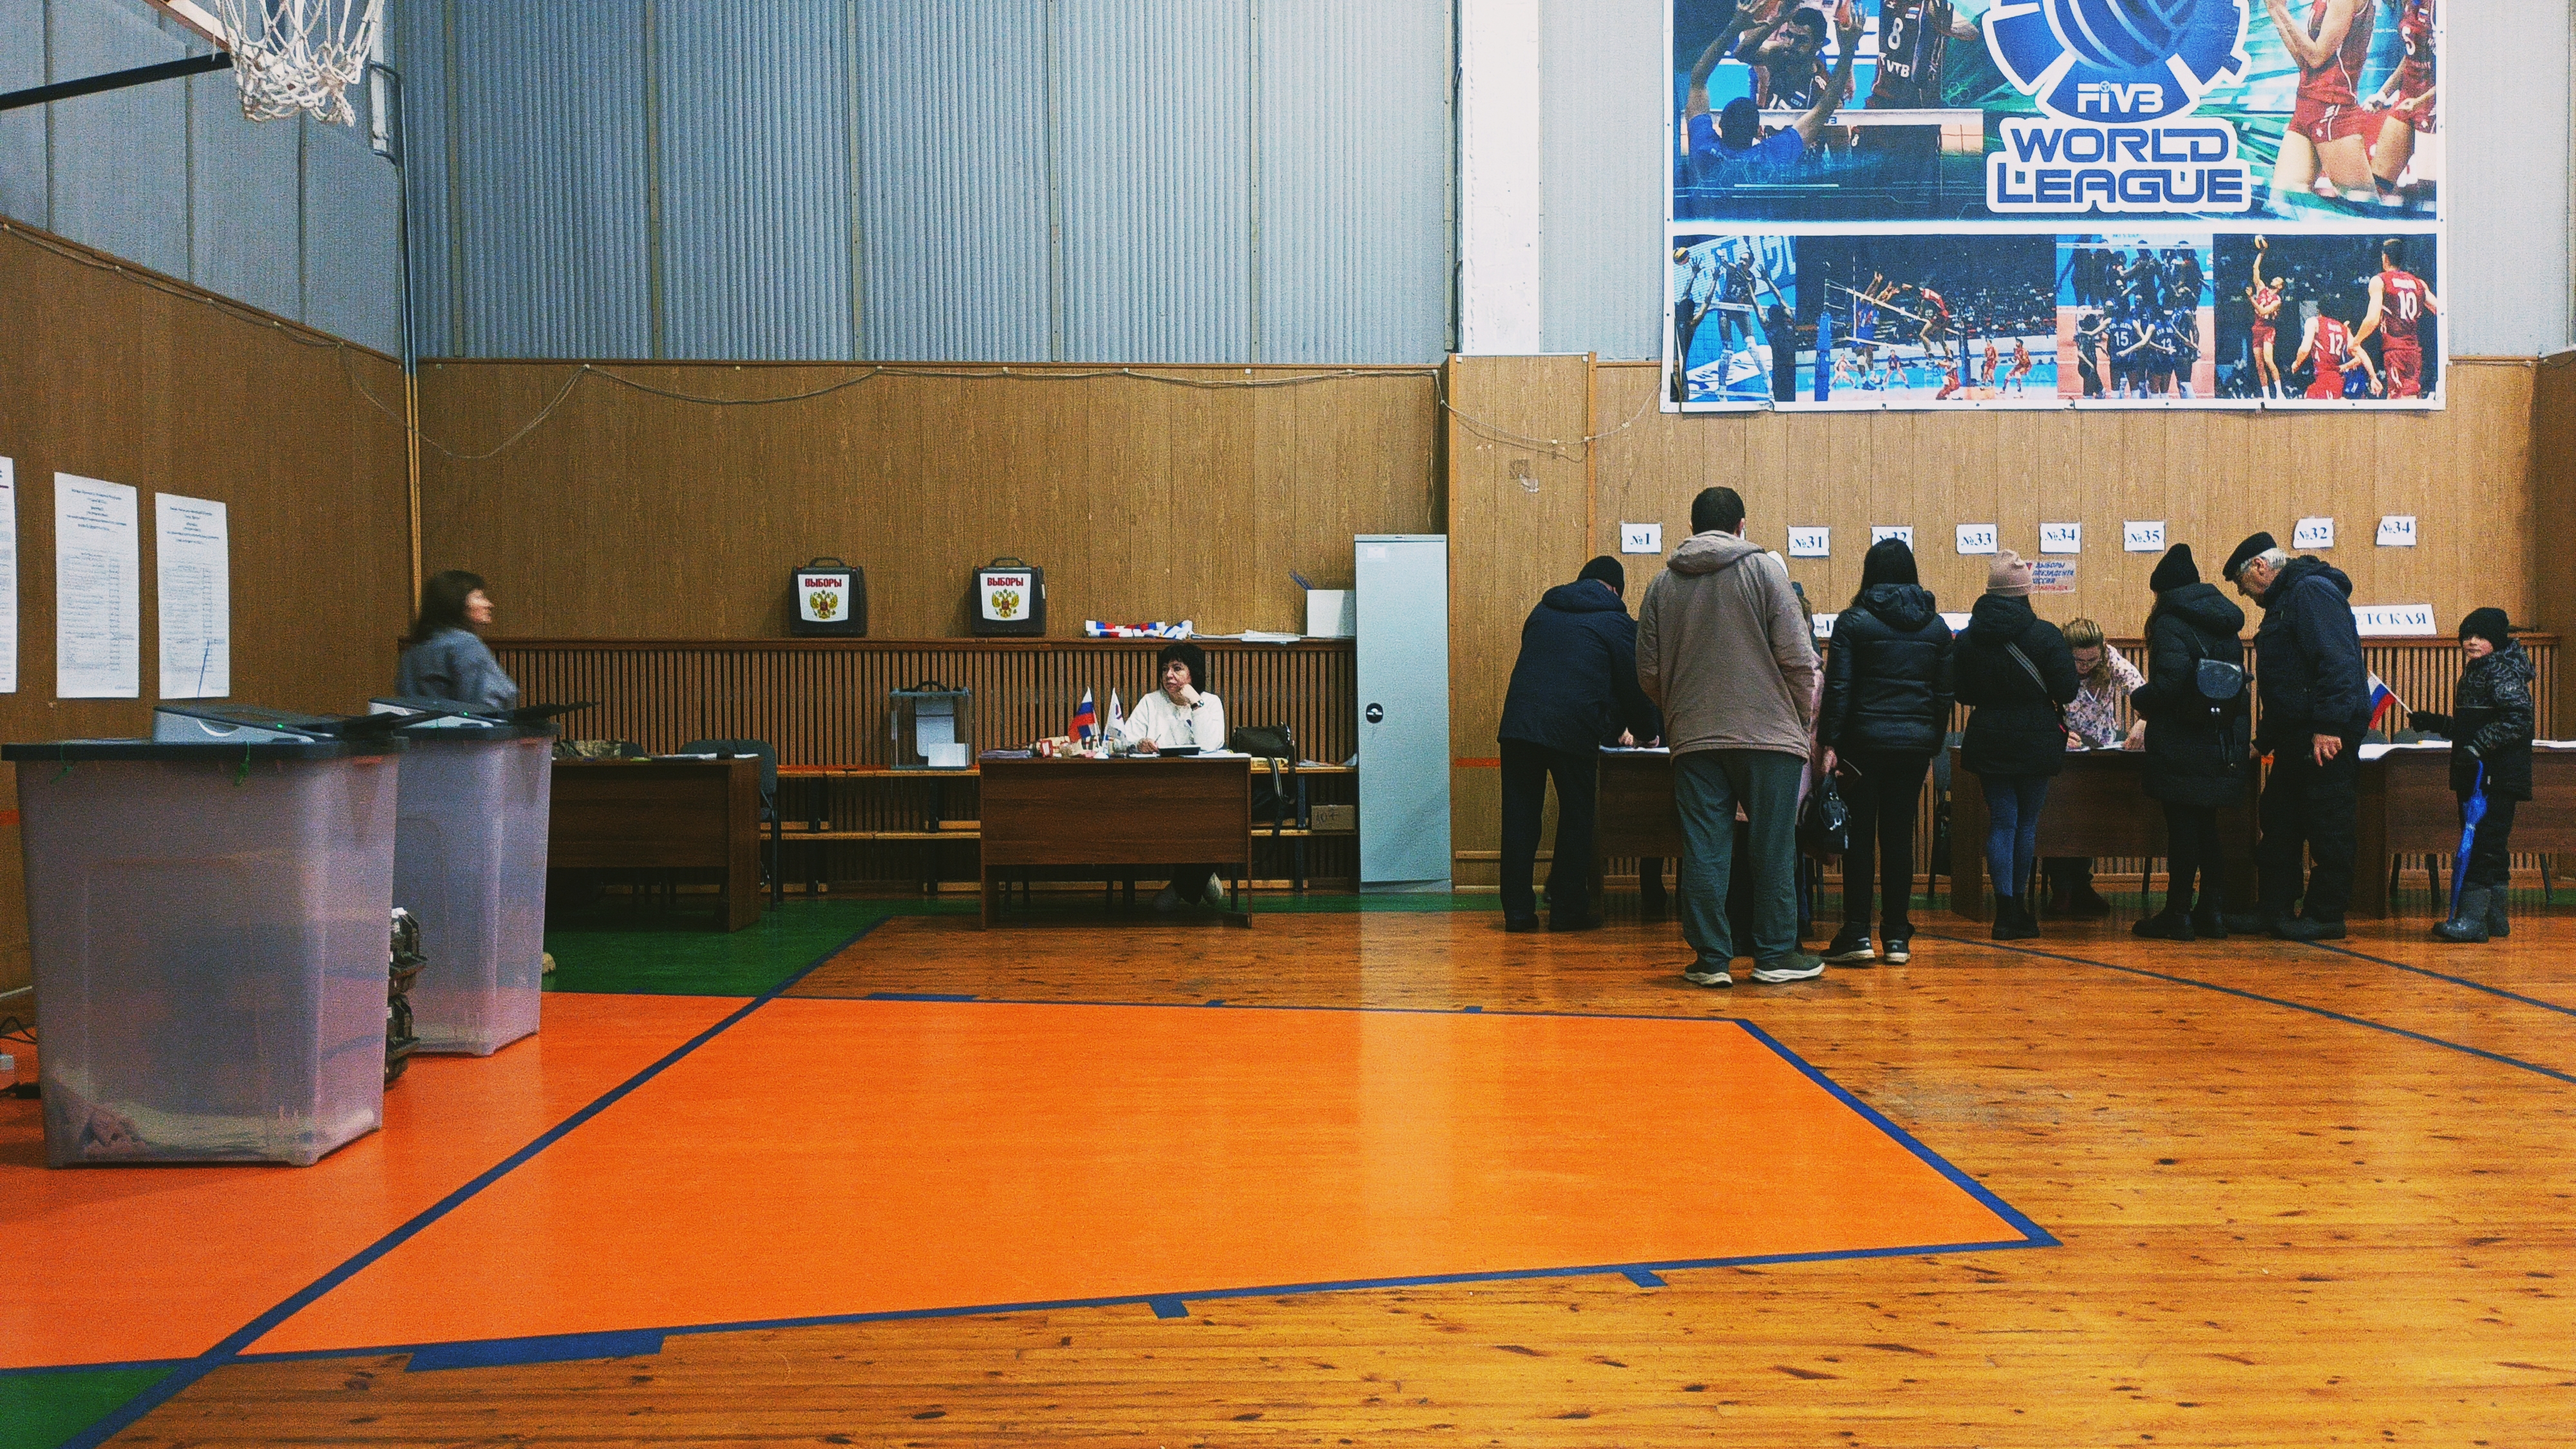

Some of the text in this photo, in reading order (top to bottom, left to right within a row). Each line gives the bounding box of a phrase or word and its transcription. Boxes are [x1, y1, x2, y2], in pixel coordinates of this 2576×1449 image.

[1888, 17, 1903, 50] 8
[1887, 59, 1910, 77] VTB
[2010, 128, 2229, 162] WORLD
[1997, 162, 2242, 204] LEAGUE
[2398, 290, 2418, 321] 10
[2114, 331, 2129, 346] 15
[2329, 332, 2344, 355] 12
[2297, 527, 2327, 540] №32
[2381, 521, 2410, 534] №34
[1630, 533, 1651, 545] №1
[1961, 533, 1992, 546] №33
[2045, 528, 2076, 542] №34
[2128, 530, 2160, 543] №35
[1793, 536, 1823, 549] №31
[805, 578, 842, 587] ВЫБОРЫ
[987, 577, 1024, 587] ВЫБОРЫ
